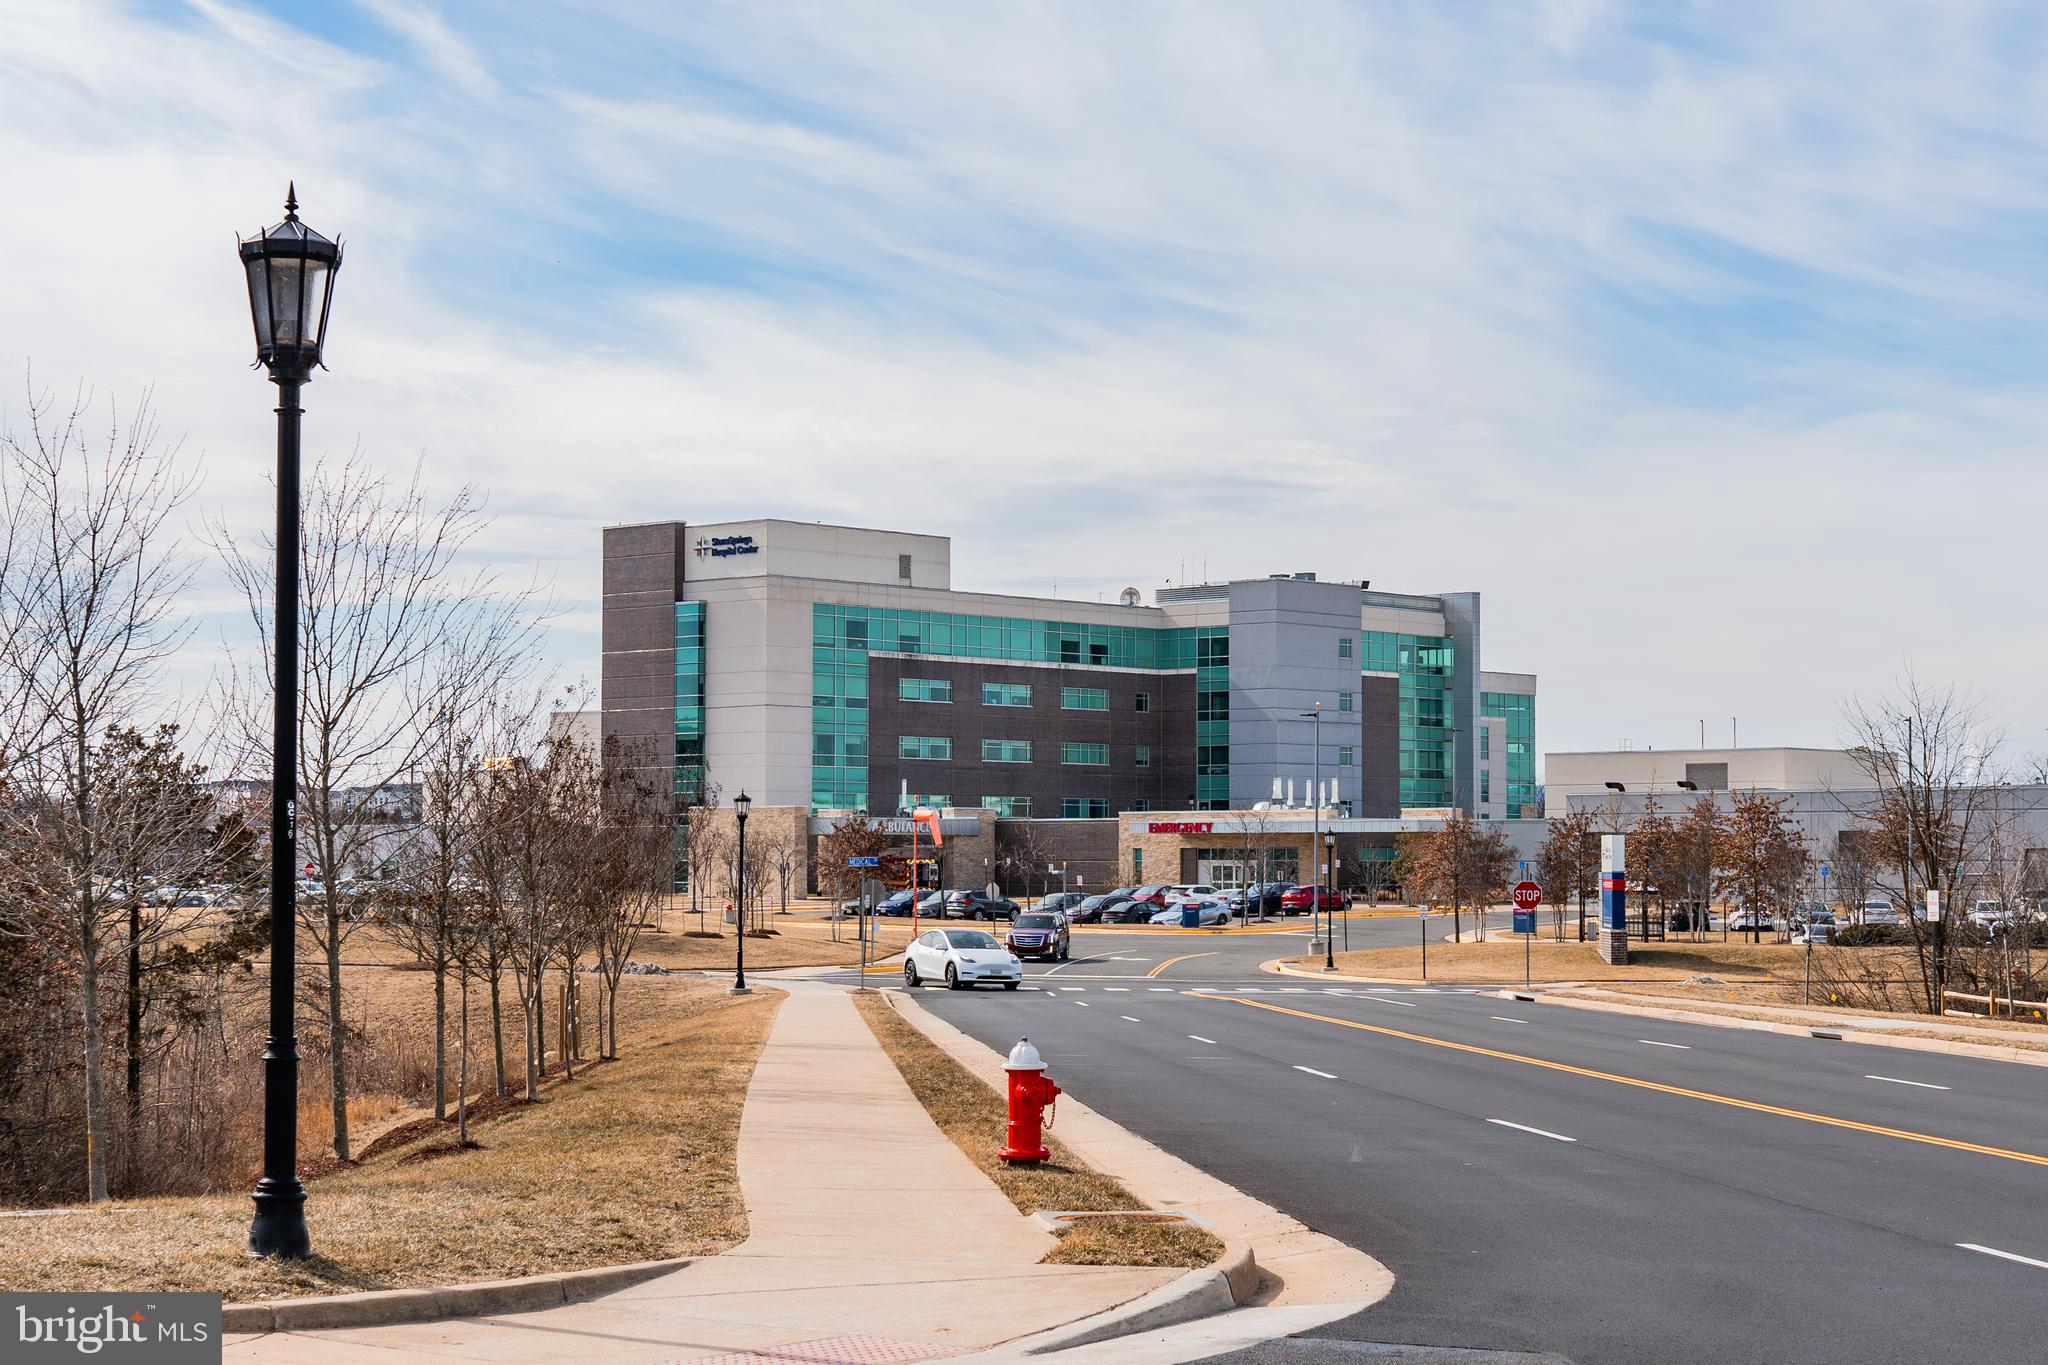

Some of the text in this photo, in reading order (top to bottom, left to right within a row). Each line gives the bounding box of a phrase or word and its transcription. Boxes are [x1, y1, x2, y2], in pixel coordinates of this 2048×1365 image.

[871, 820, 932, 833] ABULACE
[1148, 822, 1213, 833] EMERGENCY
[849, 857, 871, 865] MEDICAL
[1514, 889, 1540, 902] STOP
